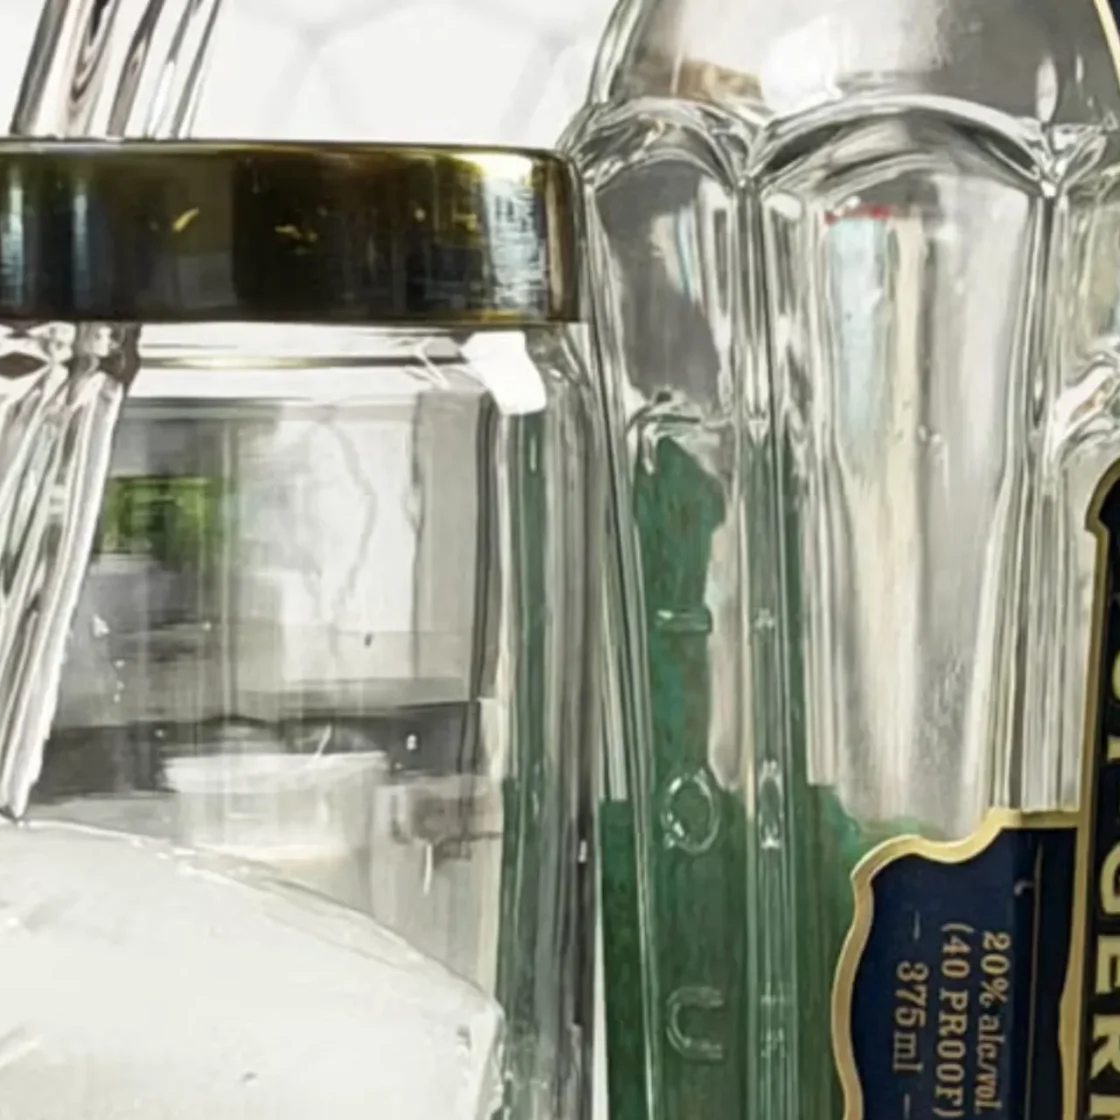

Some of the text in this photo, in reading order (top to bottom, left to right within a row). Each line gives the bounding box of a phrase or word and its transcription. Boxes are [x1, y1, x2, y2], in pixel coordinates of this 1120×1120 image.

[892, 960, 930, 1075] 375ml
[932, 922, 975, 1118] (40 PROOF)
[978, 930, 1012, 1008] 20%
